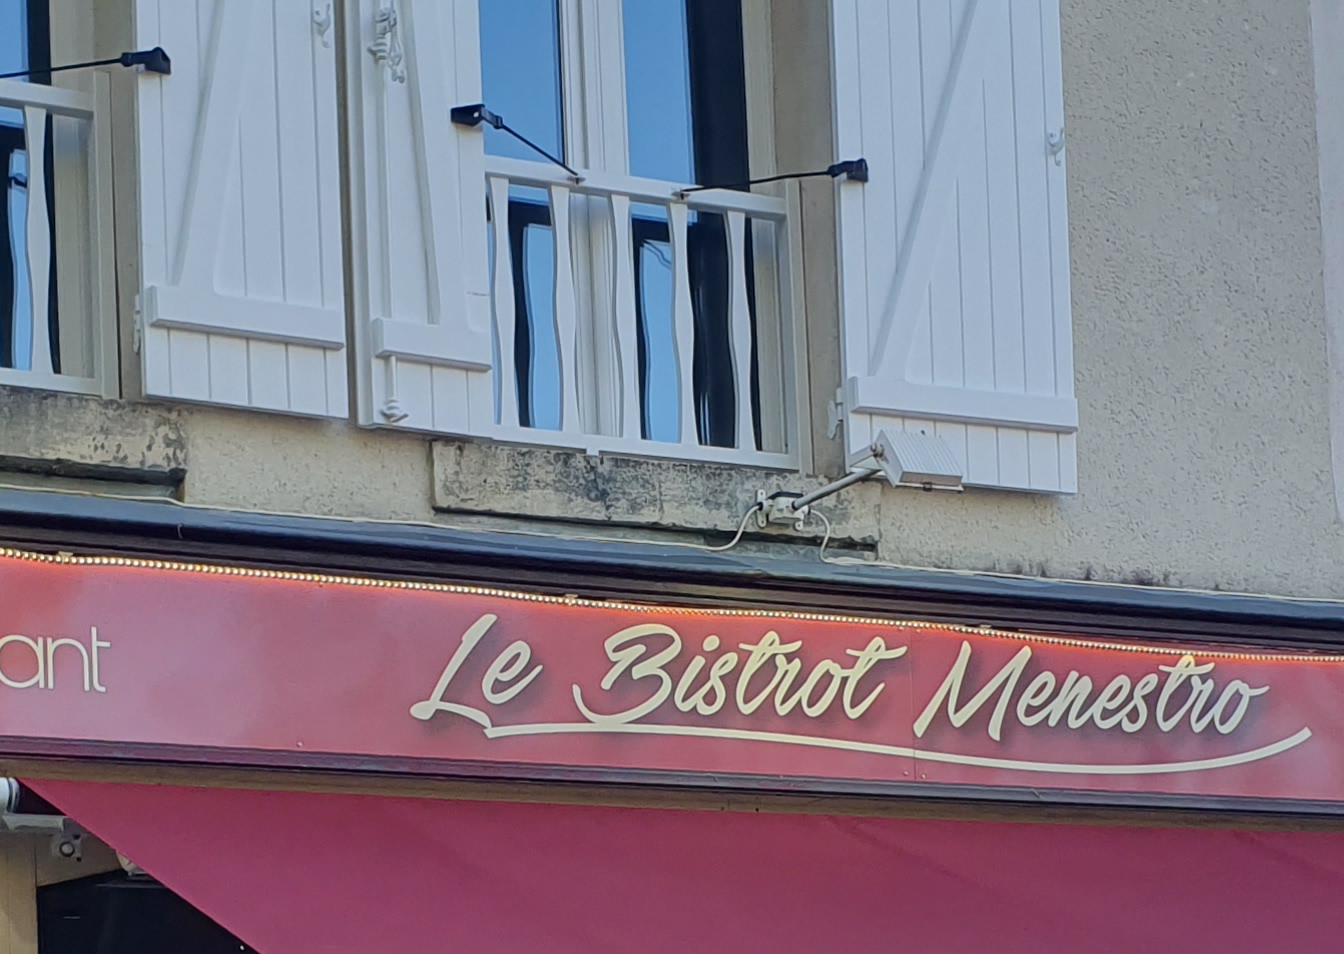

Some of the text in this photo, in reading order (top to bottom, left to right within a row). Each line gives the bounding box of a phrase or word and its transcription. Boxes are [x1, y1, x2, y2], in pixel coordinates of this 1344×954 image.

[408, 613, 1271, 742] Le Bistrot Menestro
